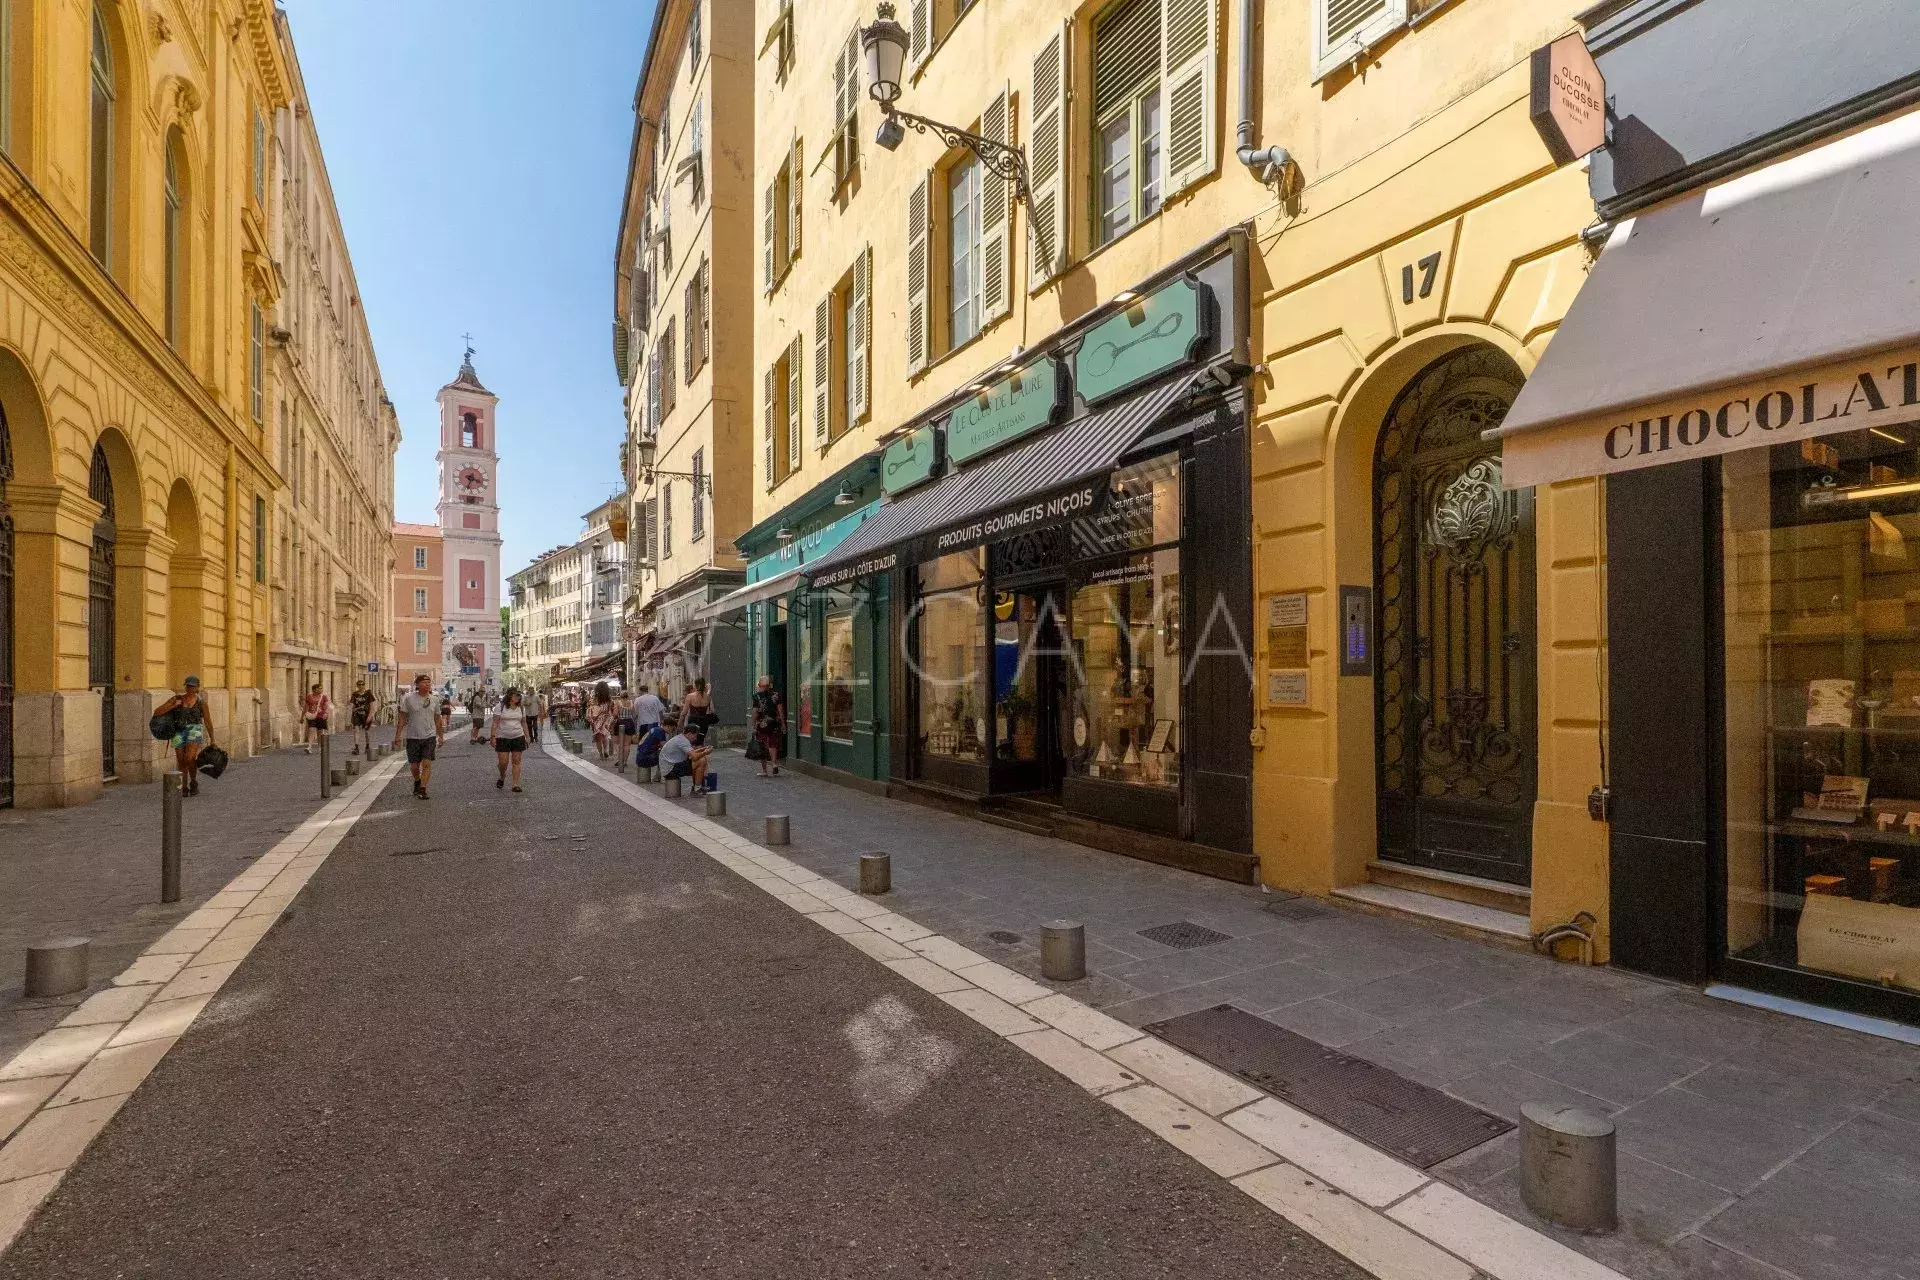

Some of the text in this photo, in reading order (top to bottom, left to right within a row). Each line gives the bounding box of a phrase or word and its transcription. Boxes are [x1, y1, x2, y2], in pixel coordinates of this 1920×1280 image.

[1553, 74, 1600, 111] DUCASSE
[1562, 97, 1589, 120] CHOCOLAT
[1402, 250, 1442, 305] 17
[955, 415, 966, 434] LE
[995, 393, 1007, 411] DE
[1010, 374, 1043, 406] LAURE
[1604, 362, 1920, 460] CHOCOLAT
[938, 488, 1093, 549] PRODUITS GOURMETS NIÇOIS
[1096, 513, 1121, 526] SYRUPS
[1126, 502, 1162, 518] CHUTNEYS
[1114, 497, 1134, 509] OLIVE
[812, 554, 897, 589] ARTISANS SUR LA CÔTE D'AZUR
[1092, 570, 1105, 579] Local
[1105, 567, 1123, 577] artisans
[1124, 565, 1137, 574] from
[1124, 574, 1137, 584] food
